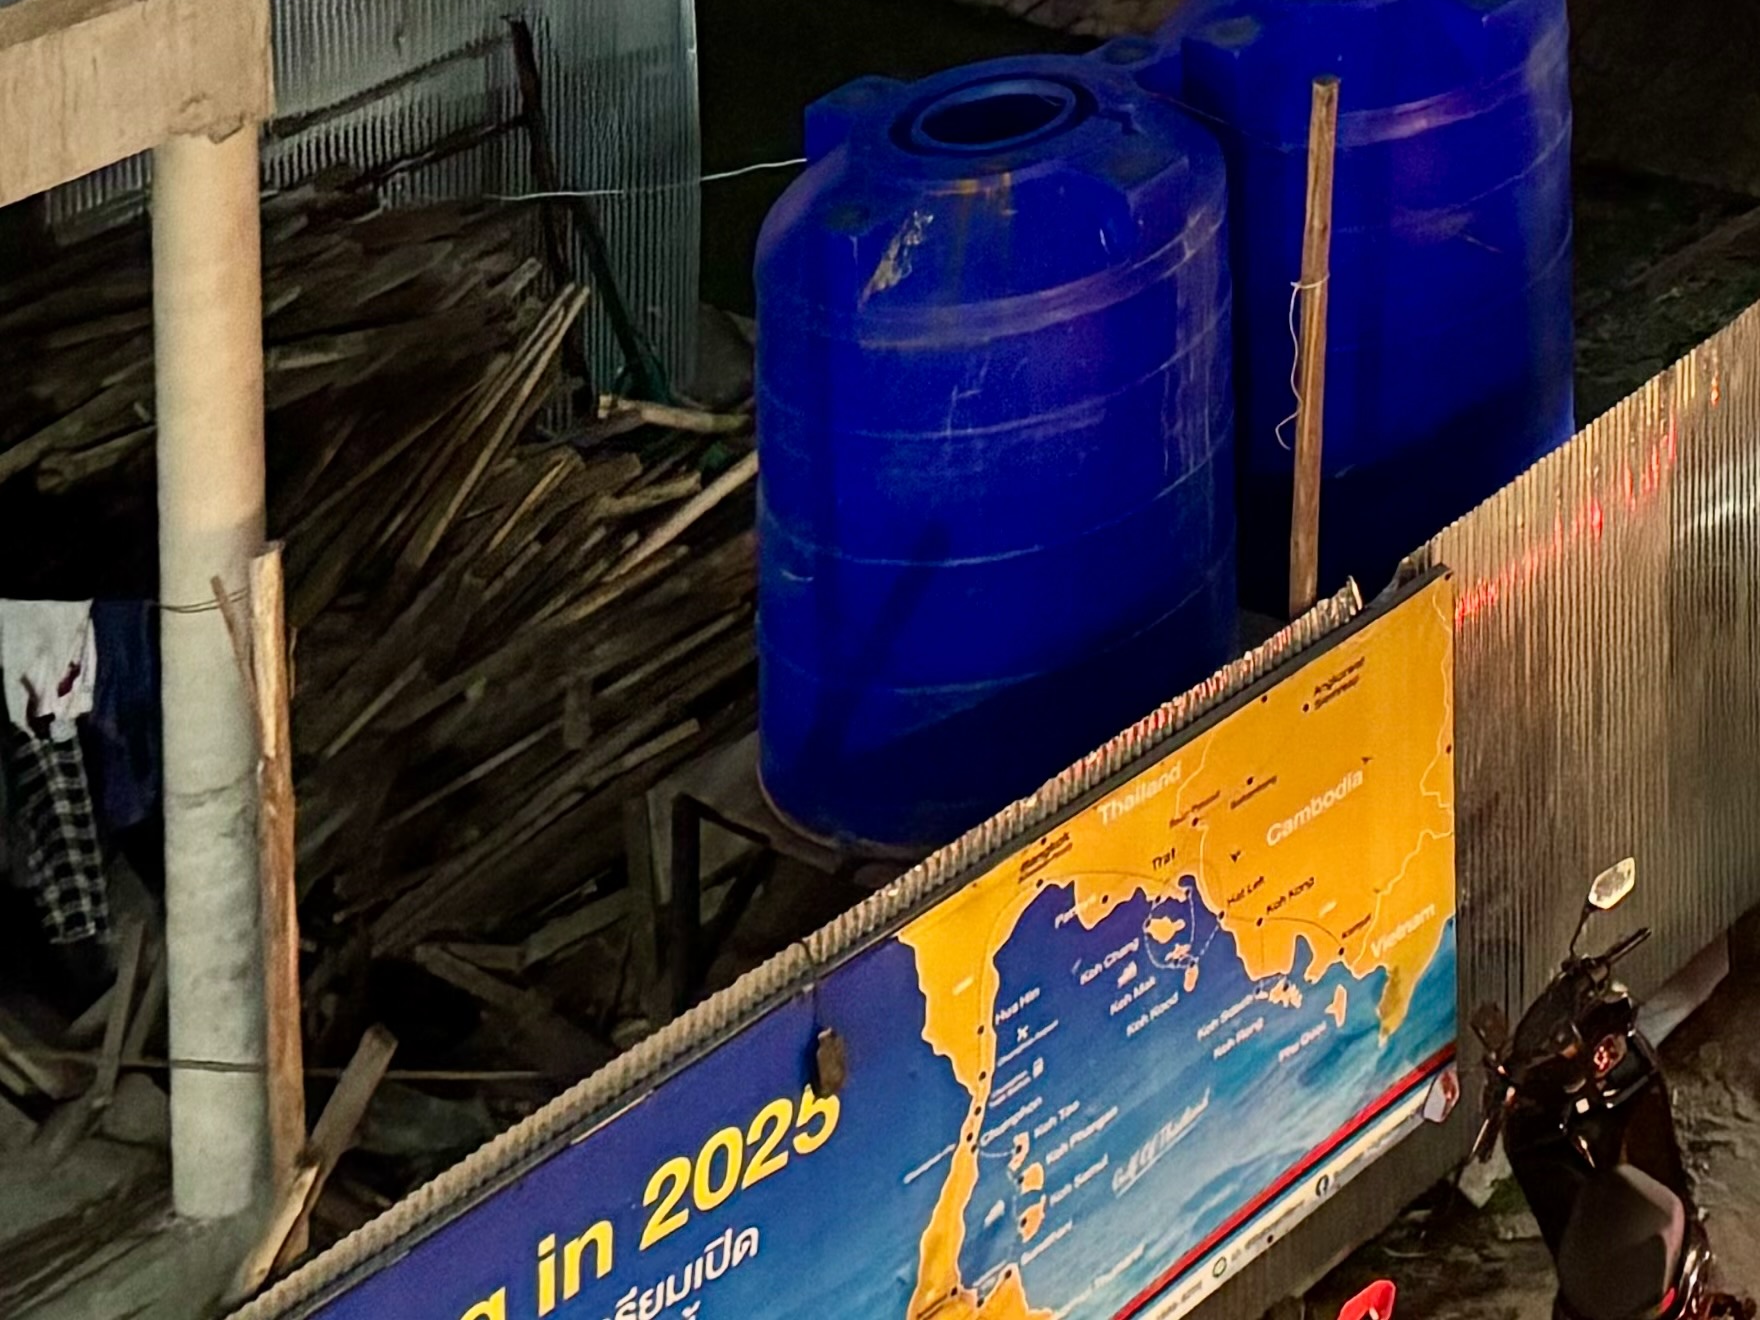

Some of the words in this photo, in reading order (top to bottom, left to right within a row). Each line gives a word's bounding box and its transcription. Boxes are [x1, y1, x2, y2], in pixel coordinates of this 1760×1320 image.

[1097, 761, 1183, 825] Thailand
[1264, 767, 1365, 848] Cambodia
[1370, 903, 1437, 959] Vietnam
[538, 1219, 613, 1317] in
[640, 1082, 842, 1250] 2025
